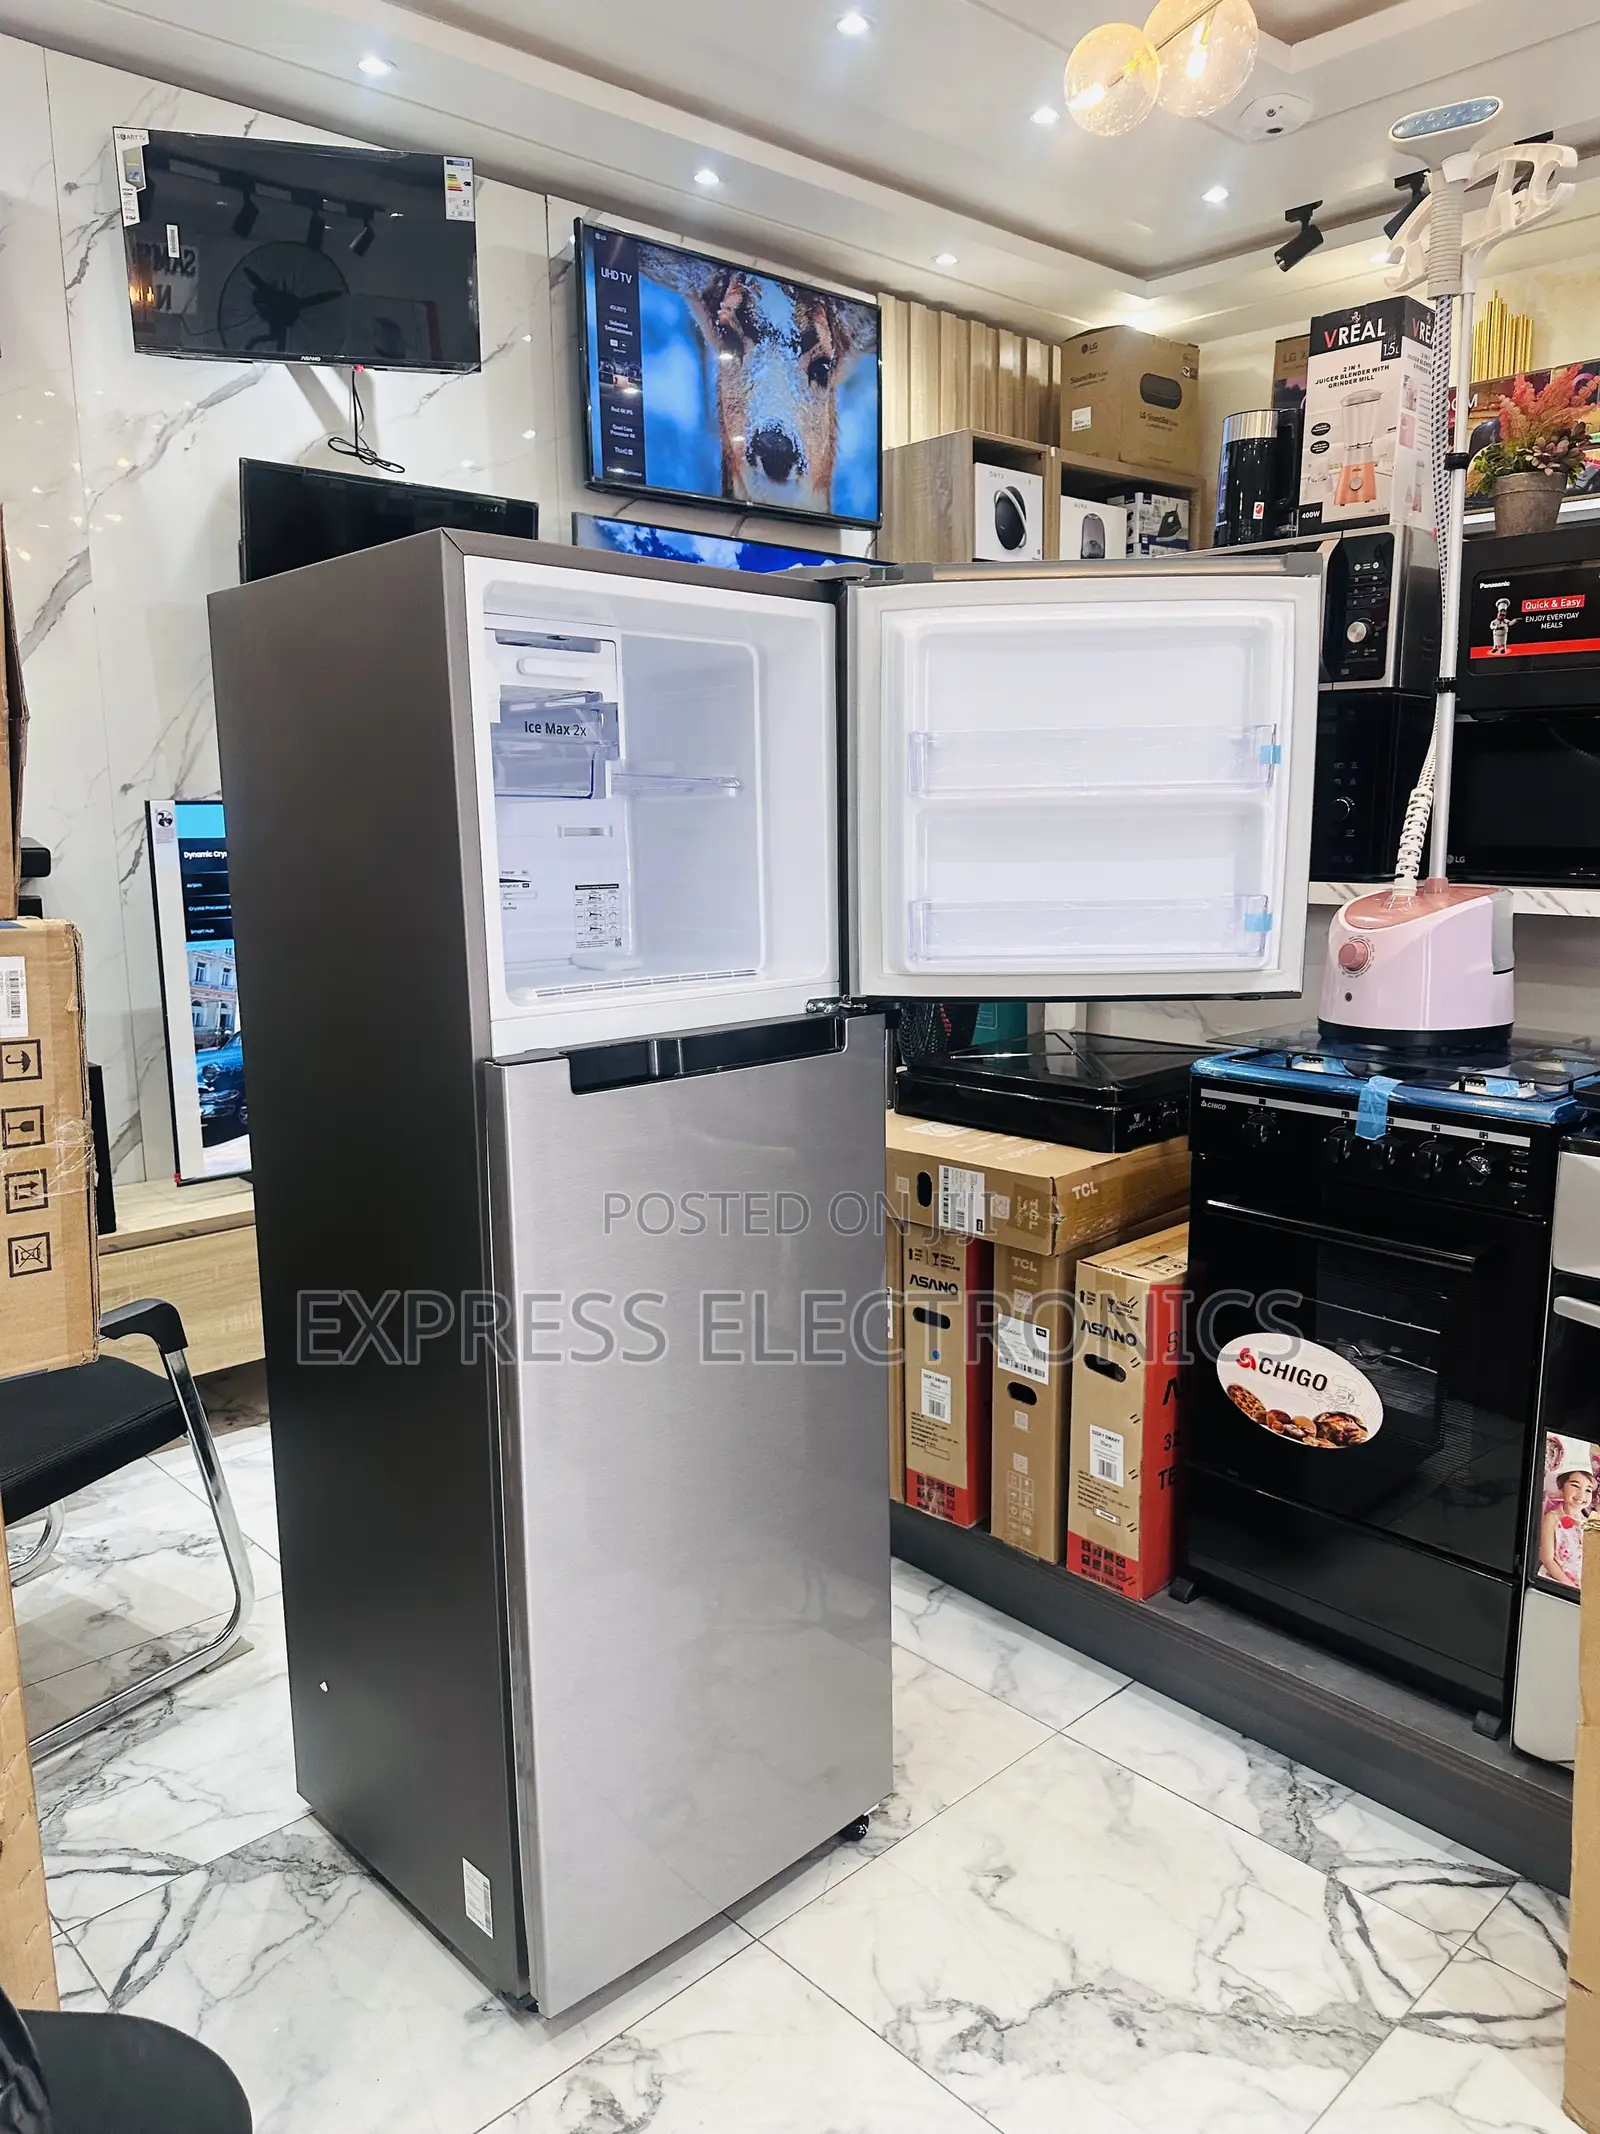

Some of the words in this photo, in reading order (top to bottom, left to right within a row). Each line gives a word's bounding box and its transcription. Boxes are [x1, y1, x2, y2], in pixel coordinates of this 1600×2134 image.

[601, 267, 619, 280] UHD
[620, 272, 632, 284] TV
[1324, 317, 1386, 348] VREAL
[1283, 353, 1297, 364] LG
[1315, 375, 1339, 385] JUICER
[1340, 369, 1371, 380] BLENDER
[1371, 364, 1390, 373] WITH
[1328, 378, 1358, 389] GRINDER
[1301, 510, 1320, 520] 400W
[1480, 581, 1511, 589] Panasonic
[1525, 601, 1549, 610] Quick
[1551, 600, 1558, 608] &
[1560, 598, 1582, 608] Easy
[1525, 614, 1546, 623] ENJOY
[1547, 612, 1580, 621] EVERYDAY
[1541, 621, 1563, 629] MEALS
[524, 720, 541, 734] Ice
[546, 722, 570, 736] Max
[573, 724, 587, 736] 2x
[183, 850, 213, 860] Dynamic
[1207, 1102, 1227, 1110] CHIGO
[1071, 1181, 1099, 1200] TCL
[1029, 1198, 1039, 1230] TCL
[1011, 1256, 1038, 1272] TCL
[909, 1274, 958, 1295] ASANO
[1080, 1319, 1137, 1346] ASANO
[1258, 1357, 1328, 1392] CHIGO
[1105, 1434, 1120, 1443] SMART
